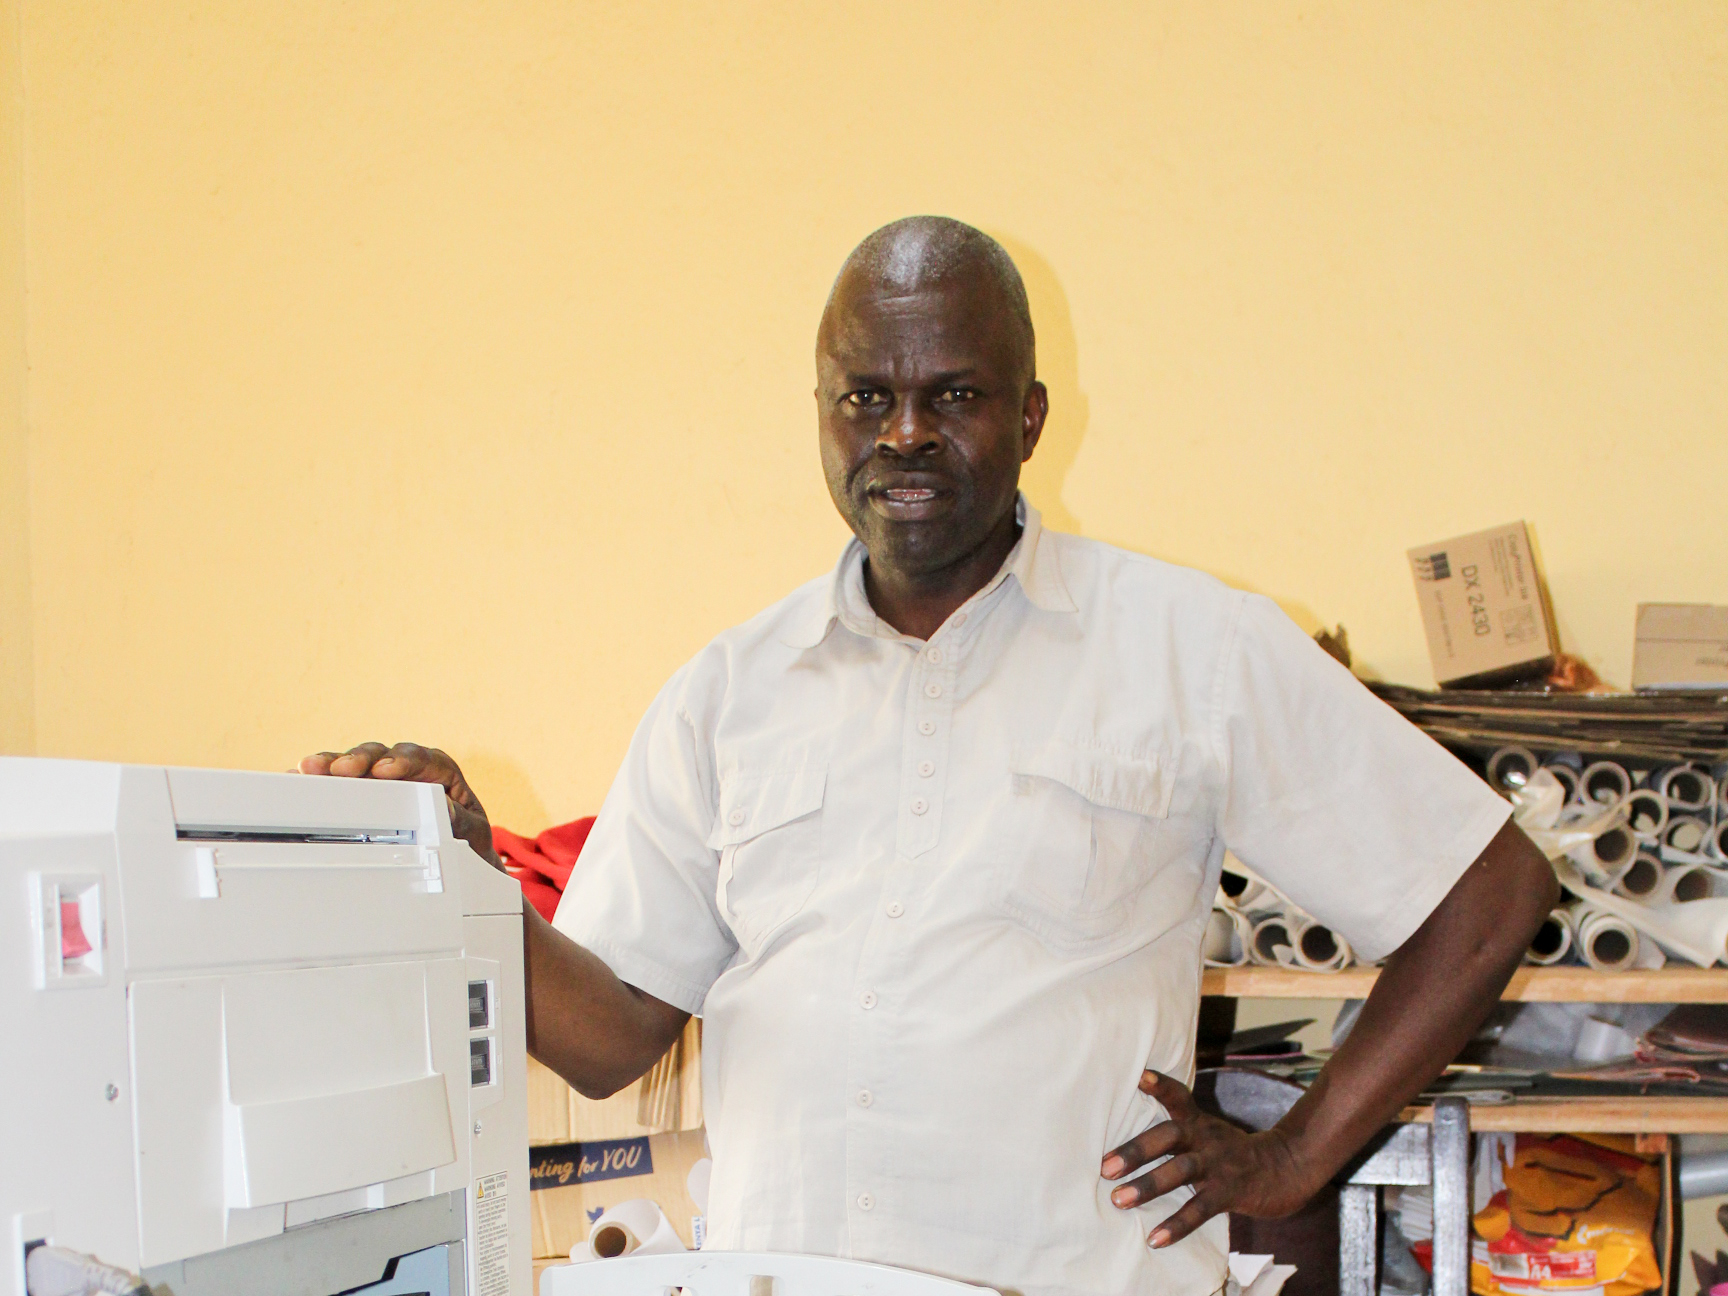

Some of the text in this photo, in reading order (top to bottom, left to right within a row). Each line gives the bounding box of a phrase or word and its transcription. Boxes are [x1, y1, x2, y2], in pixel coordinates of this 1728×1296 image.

[1461, 564, 1491, 636] DX 2430
[577, 1155, 599, 1178] for
[601, 1146, 642, 1172] YOU
[1530, 1263, 1551, 1280] A4
